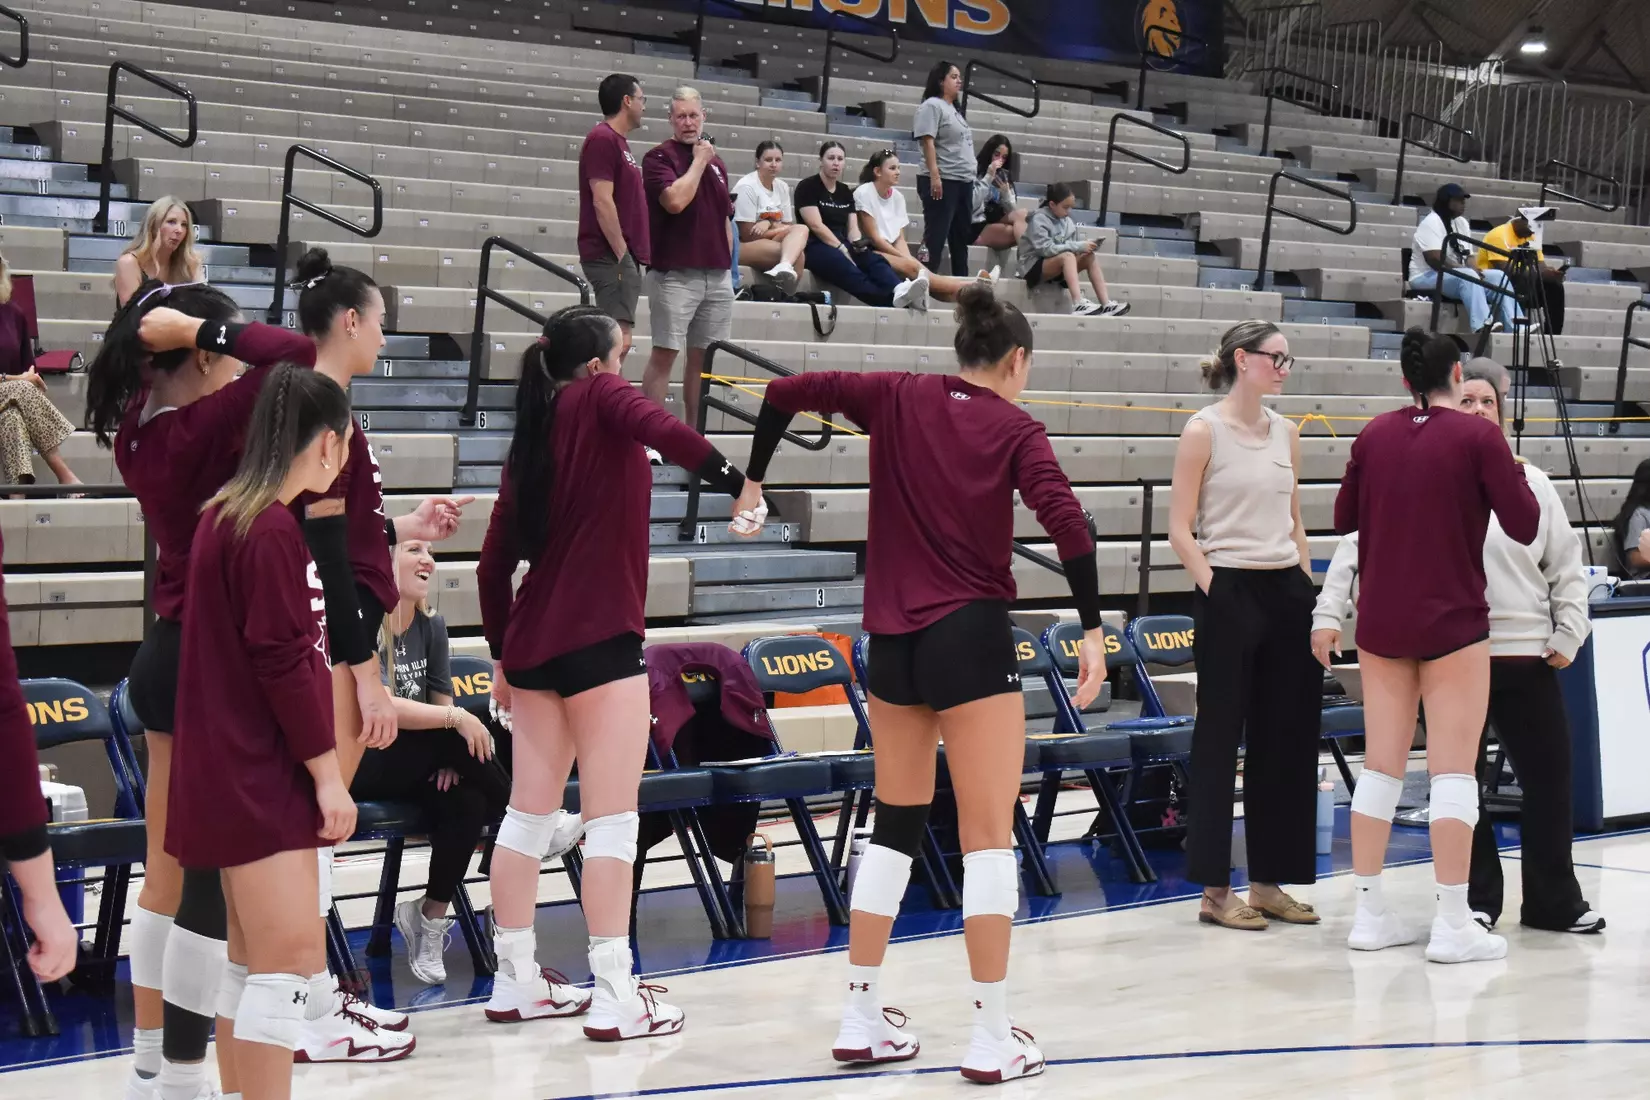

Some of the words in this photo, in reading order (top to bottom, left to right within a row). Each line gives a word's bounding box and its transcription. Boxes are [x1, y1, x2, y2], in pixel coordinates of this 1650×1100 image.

[39, 180, 48, 194] 11
[114, 221, 126, 236] 10
[288, 312, 295, 327] 8
[384, 360, 392, 376] 7
[361, 413, 369, 430] B
[479, 412, 486, 427] 6
[699, 525, 706, 543] 4
[782, 524, 789, 542] C
[817, 588, 824, 606] 3
[761, 649, 835, 676] LIONS
